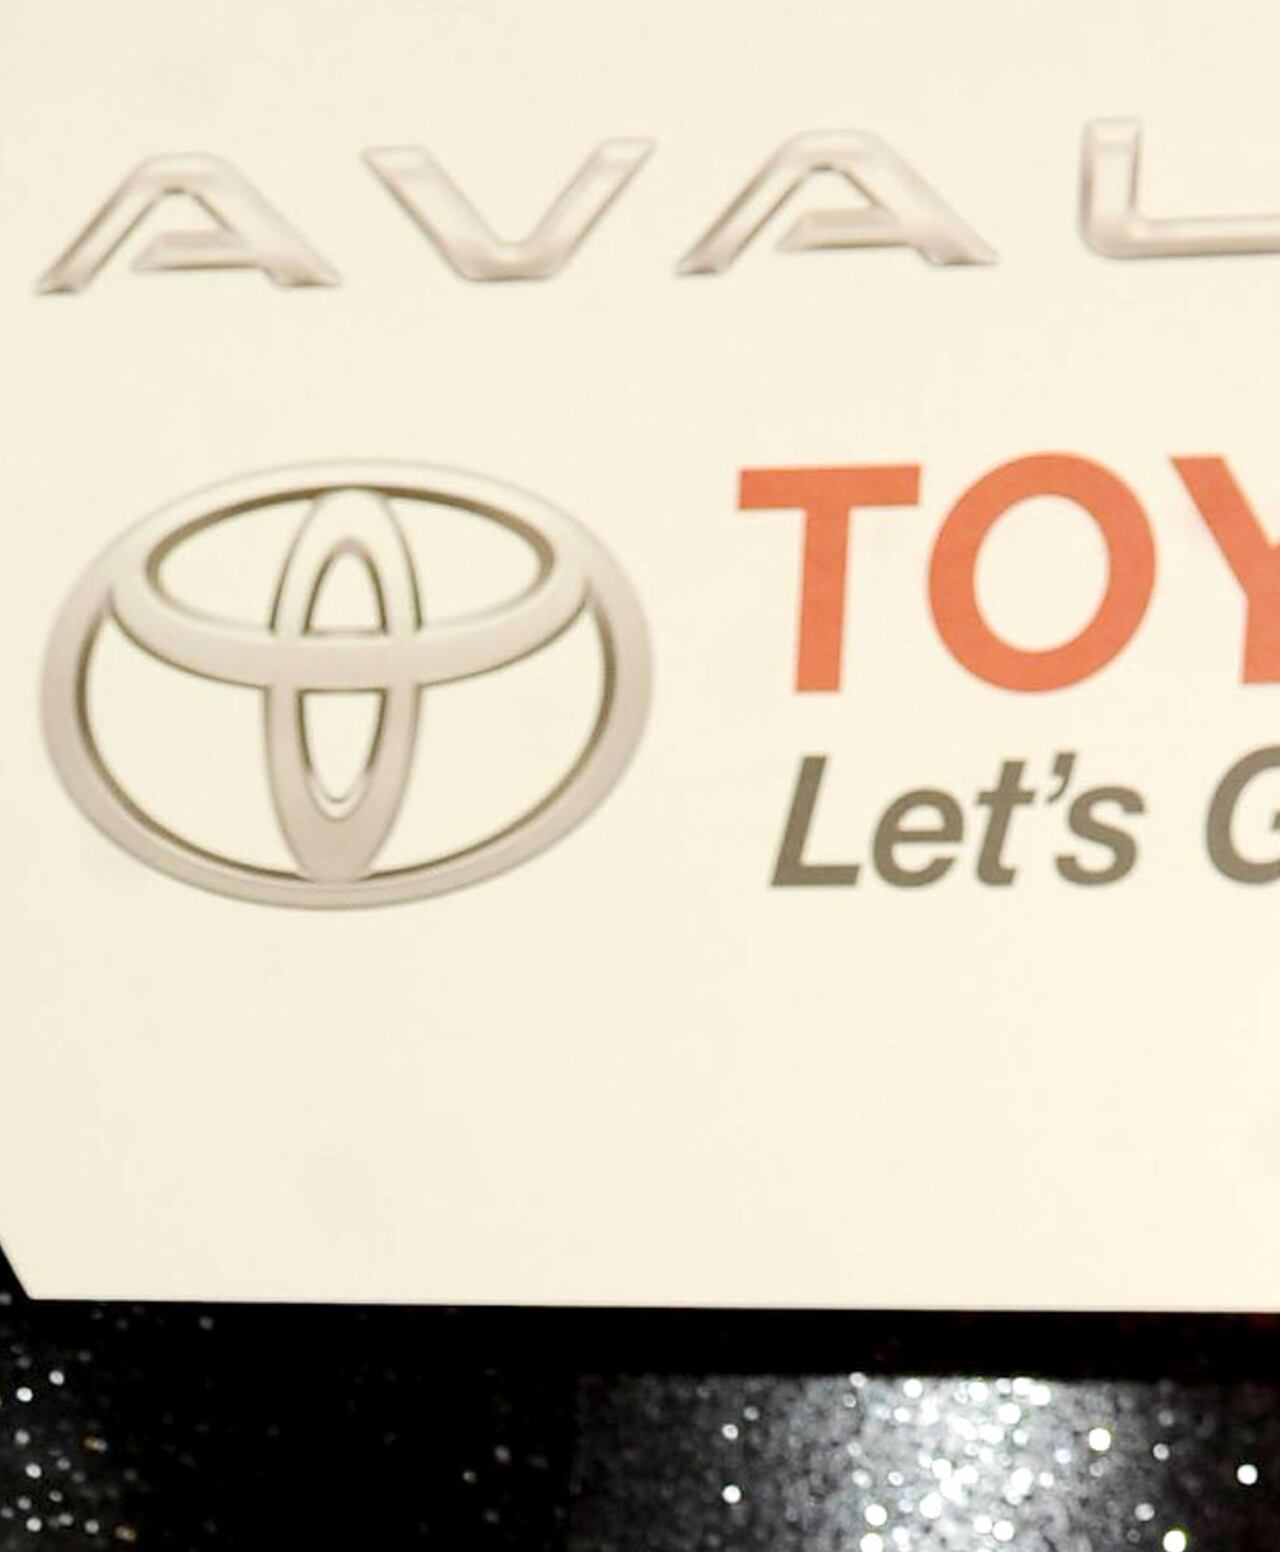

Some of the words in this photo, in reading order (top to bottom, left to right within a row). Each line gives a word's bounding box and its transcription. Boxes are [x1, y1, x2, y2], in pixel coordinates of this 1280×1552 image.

[35, 115, 1280, 296] AVAL
[737, 451, 1280, 694] TOY
[769, 750, 1146, 889] Let's
